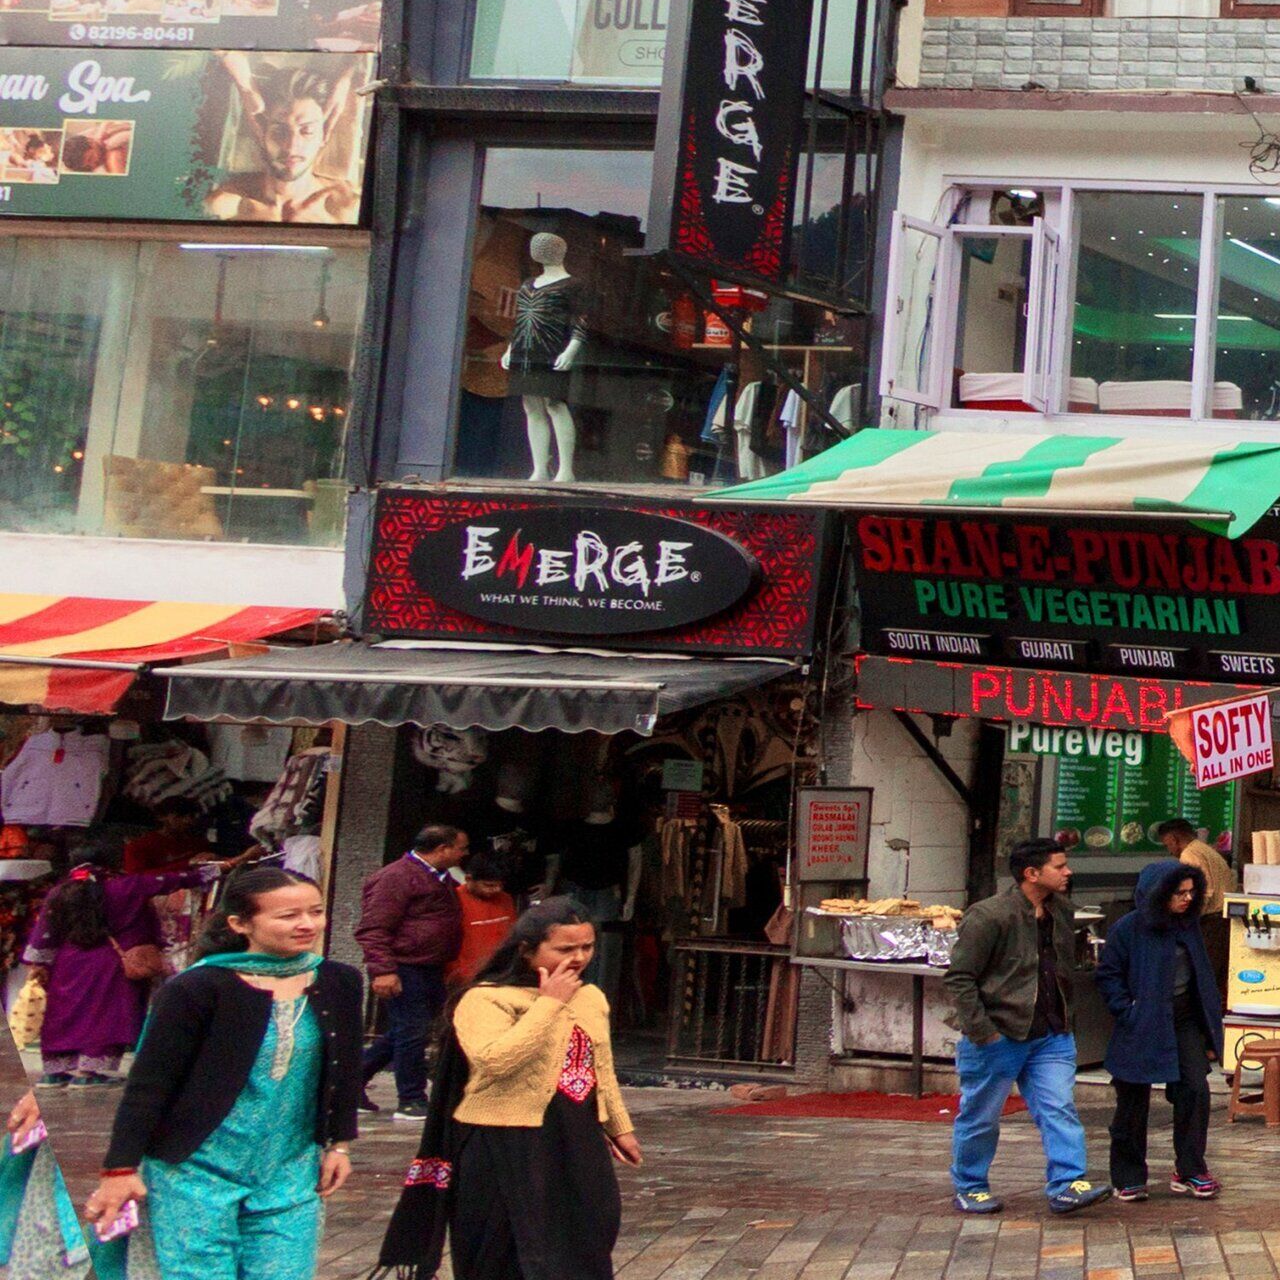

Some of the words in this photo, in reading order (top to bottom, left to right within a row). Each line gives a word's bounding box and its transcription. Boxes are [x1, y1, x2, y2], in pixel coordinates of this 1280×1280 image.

[88, 25, 195, 41] 82196-80481
[59, 60, 151, 113] Spa
[460, 525, 695, 597] EMERGE
[480, 592, 516, 605] WHAT
[518, 594, 539, 606] WE
[543, 595, 584, 608] THINK,
[588, 597, 607, 609] WE
[610, 598, 667, 611] BECOME.
[915, 578, 1009, 620] PURE
[1021, 587, 1242, 636] VEGETARIAN
[888, 630, 932, 651] SOUTH
[936, 633, 982, 656] INDIAN
[1020, 640, 1075, 662] GUJRATI
[1119, 647, 1176, 669] PUNJABI
[1221, 654, 1276, 676] SWEETS
[971, 671, 1185, 727] PUNJABI
[1199, 706, 1268, 767] SOFTY
[1202, 761, 1227, 784] ALL
[1230, 757, 1246, 777] IN
[1247, 748, 1273, 772] ONE
